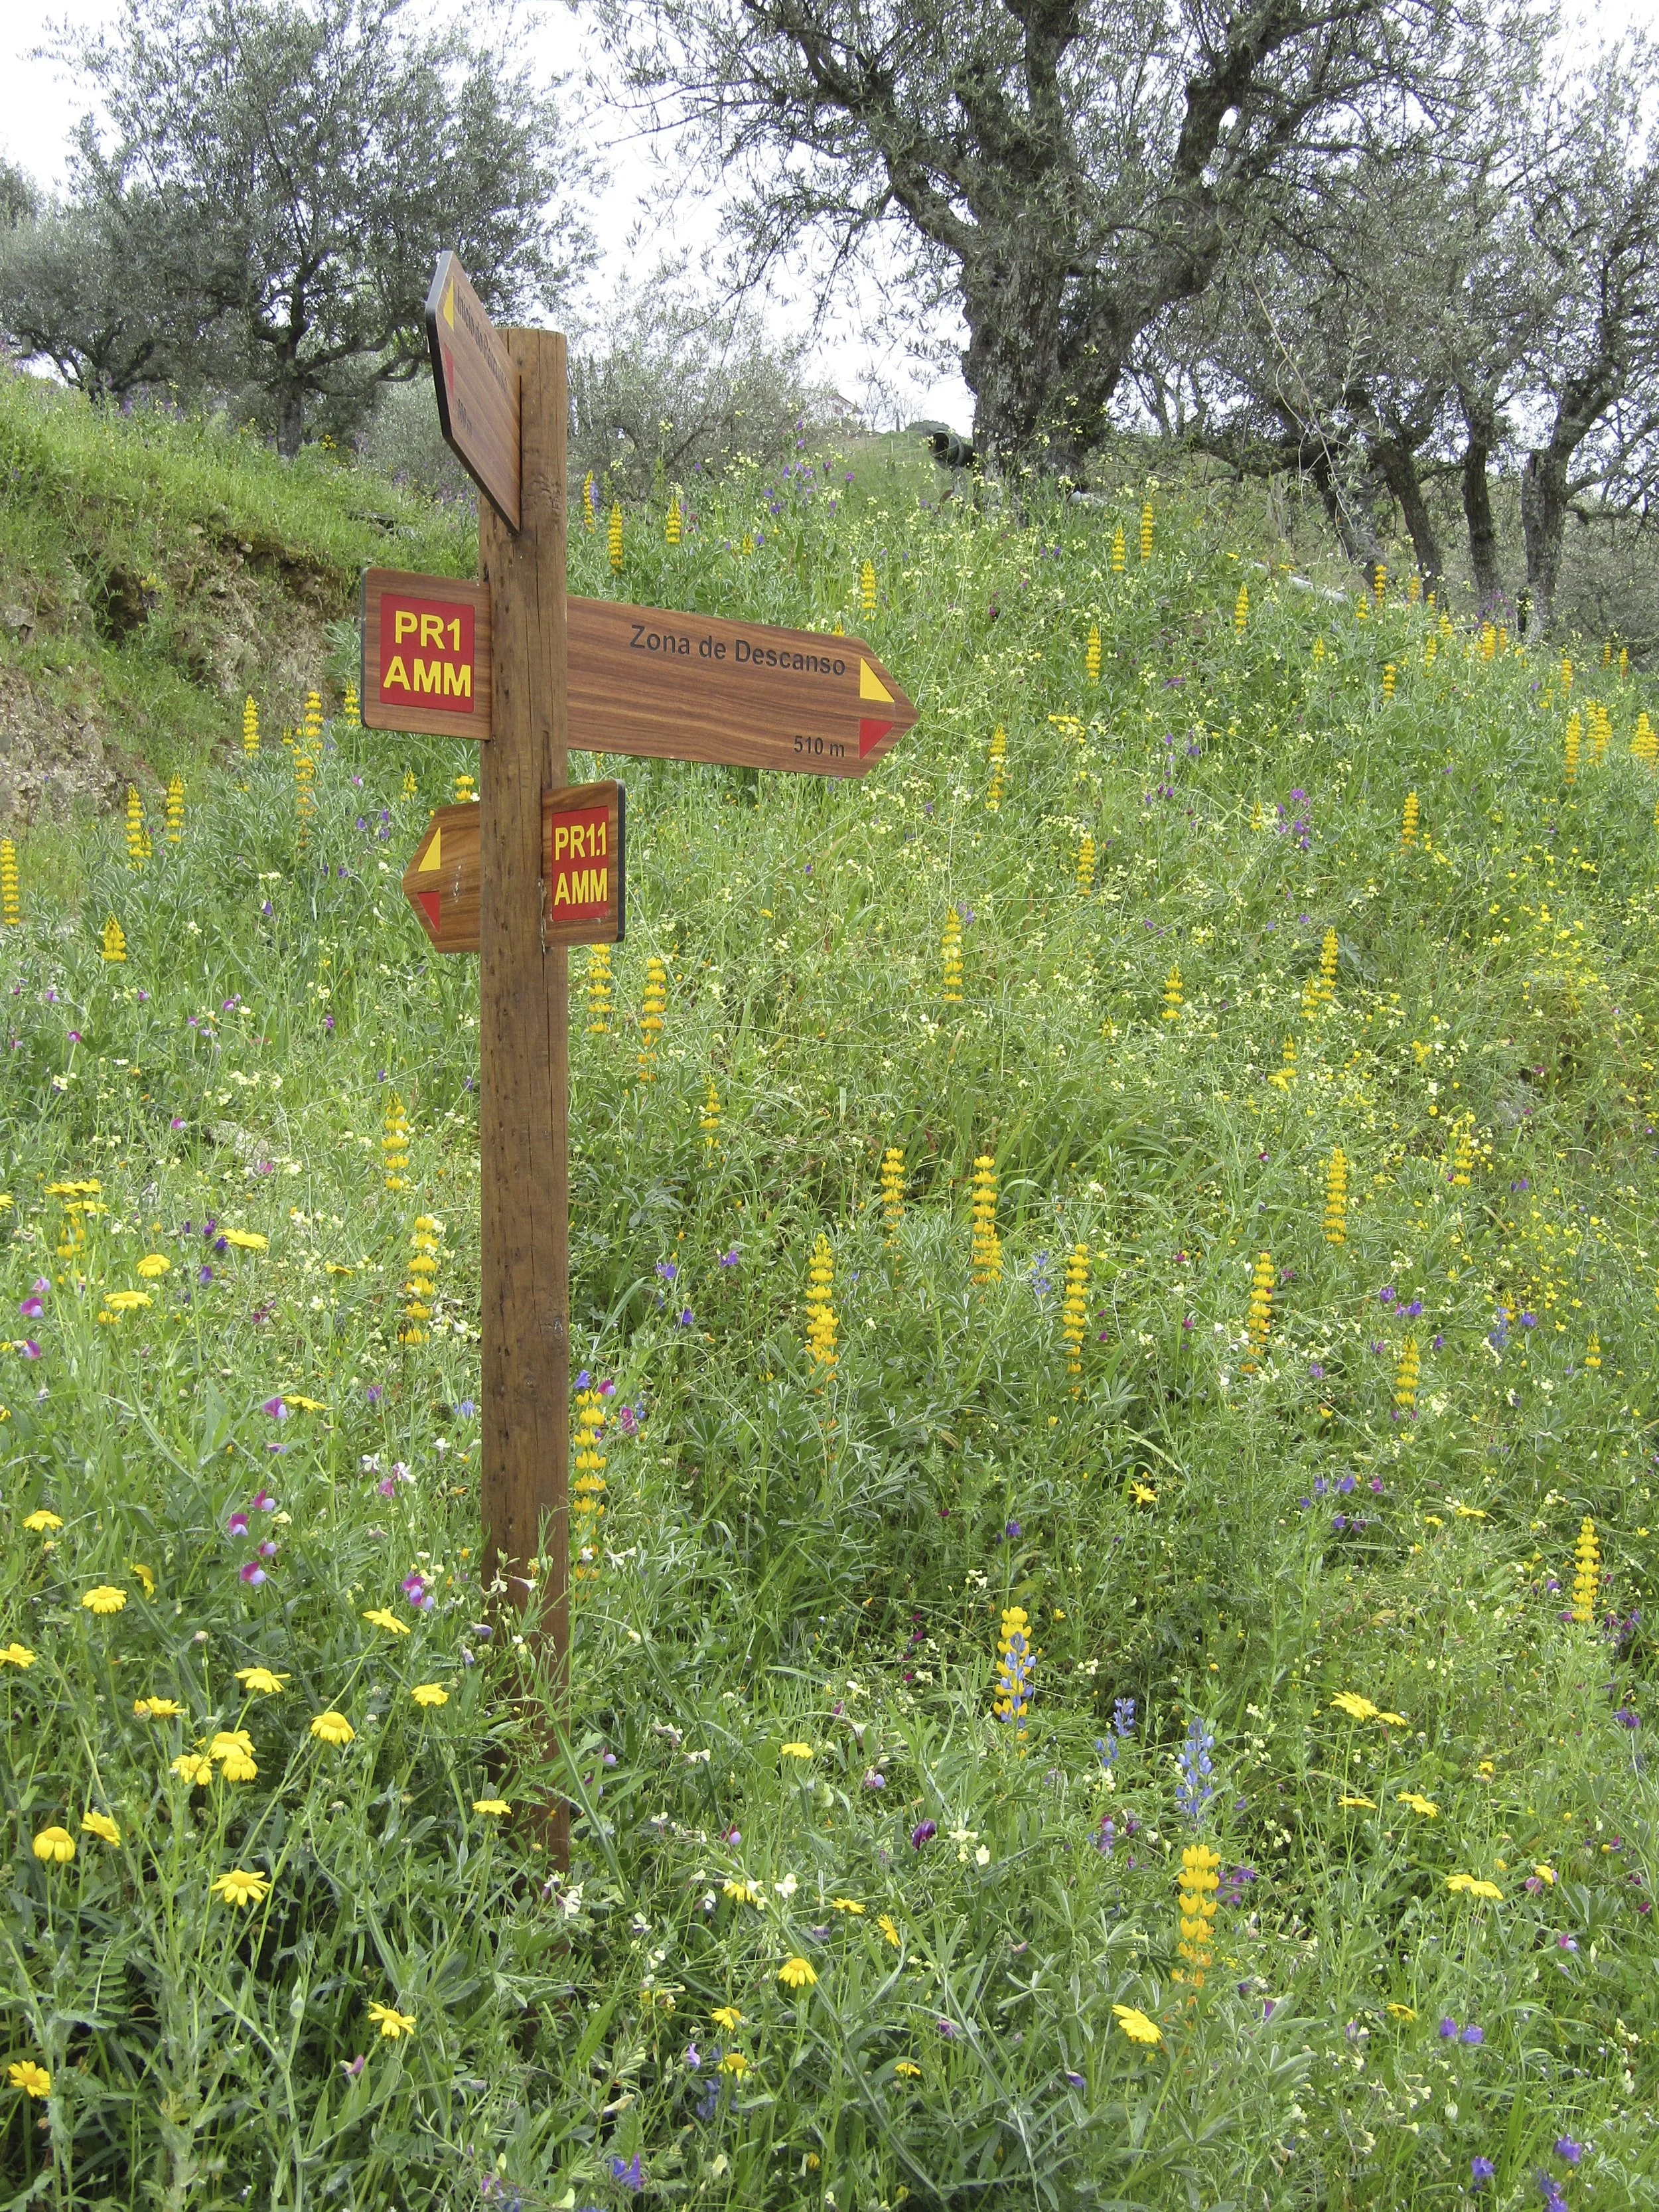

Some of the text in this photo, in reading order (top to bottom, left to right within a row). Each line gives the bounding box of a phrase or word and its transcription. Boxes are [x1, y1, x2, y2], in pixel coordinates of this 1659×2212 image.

[475, 321, 483, 352] do
[394, 610, 461, 652] PR1
[629, 625, 846, 676] Zona de Descanso
[383, 656, 471, 698] AMM
[794, 735, 845, 758] 510 m
[554, 822, 607, 861] PR1.1
[553, 867, 608, 907] AMM
